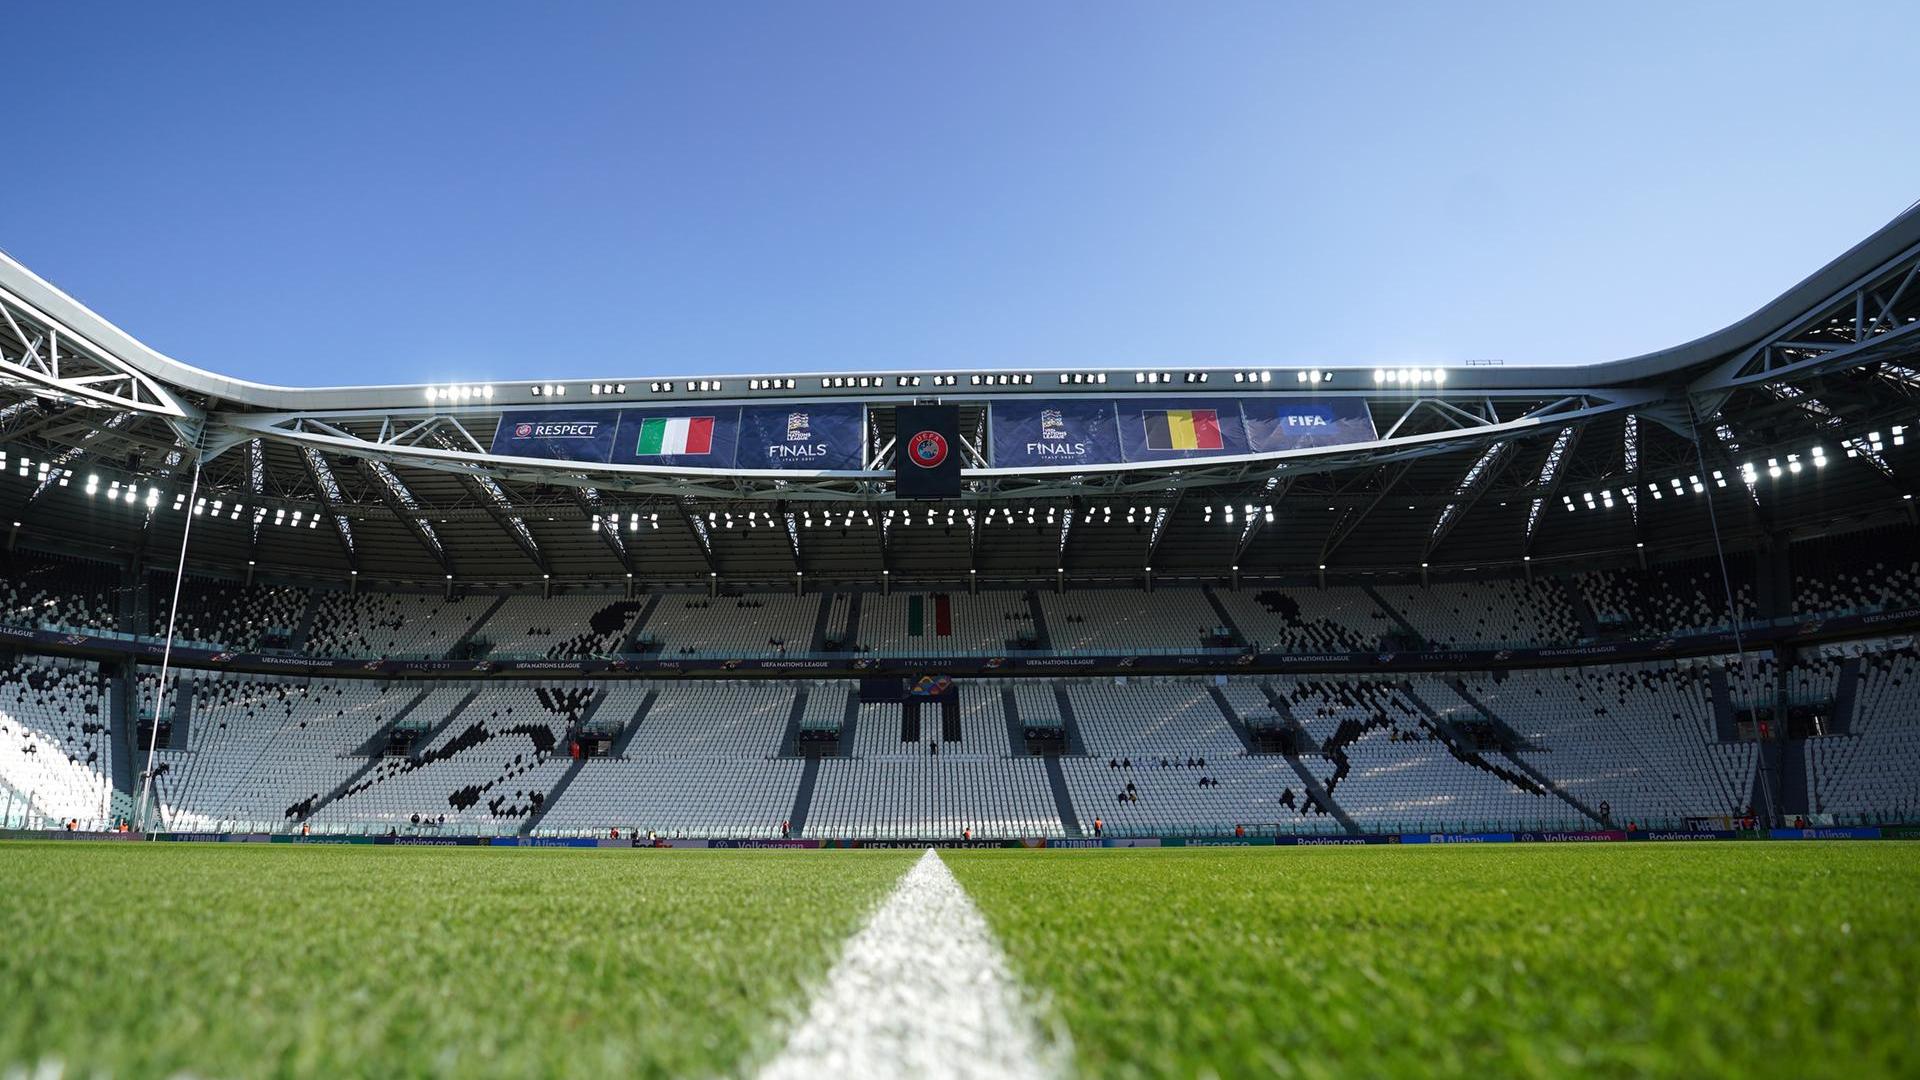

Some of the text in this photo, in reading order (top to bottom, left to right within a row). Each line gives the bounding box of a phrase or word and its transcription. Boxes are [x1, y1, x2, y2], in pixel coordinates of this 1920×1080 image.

[1288, 415, 1327, 426] FIFA
[535, 425, 597, 435] RESPECT
[769, 444, 828, 457] FINALS
[1027, 442, 1085, 455] FINALS
[4, 627, 34, 638] LEAGUE
[278, 658, 308, 666] NATIONS
[1297, 837, 1366, 845] Booking.com
[1543, 833, 1612, 842] Volkswagen
[1649, 832, 1716, 840] Booking.com
